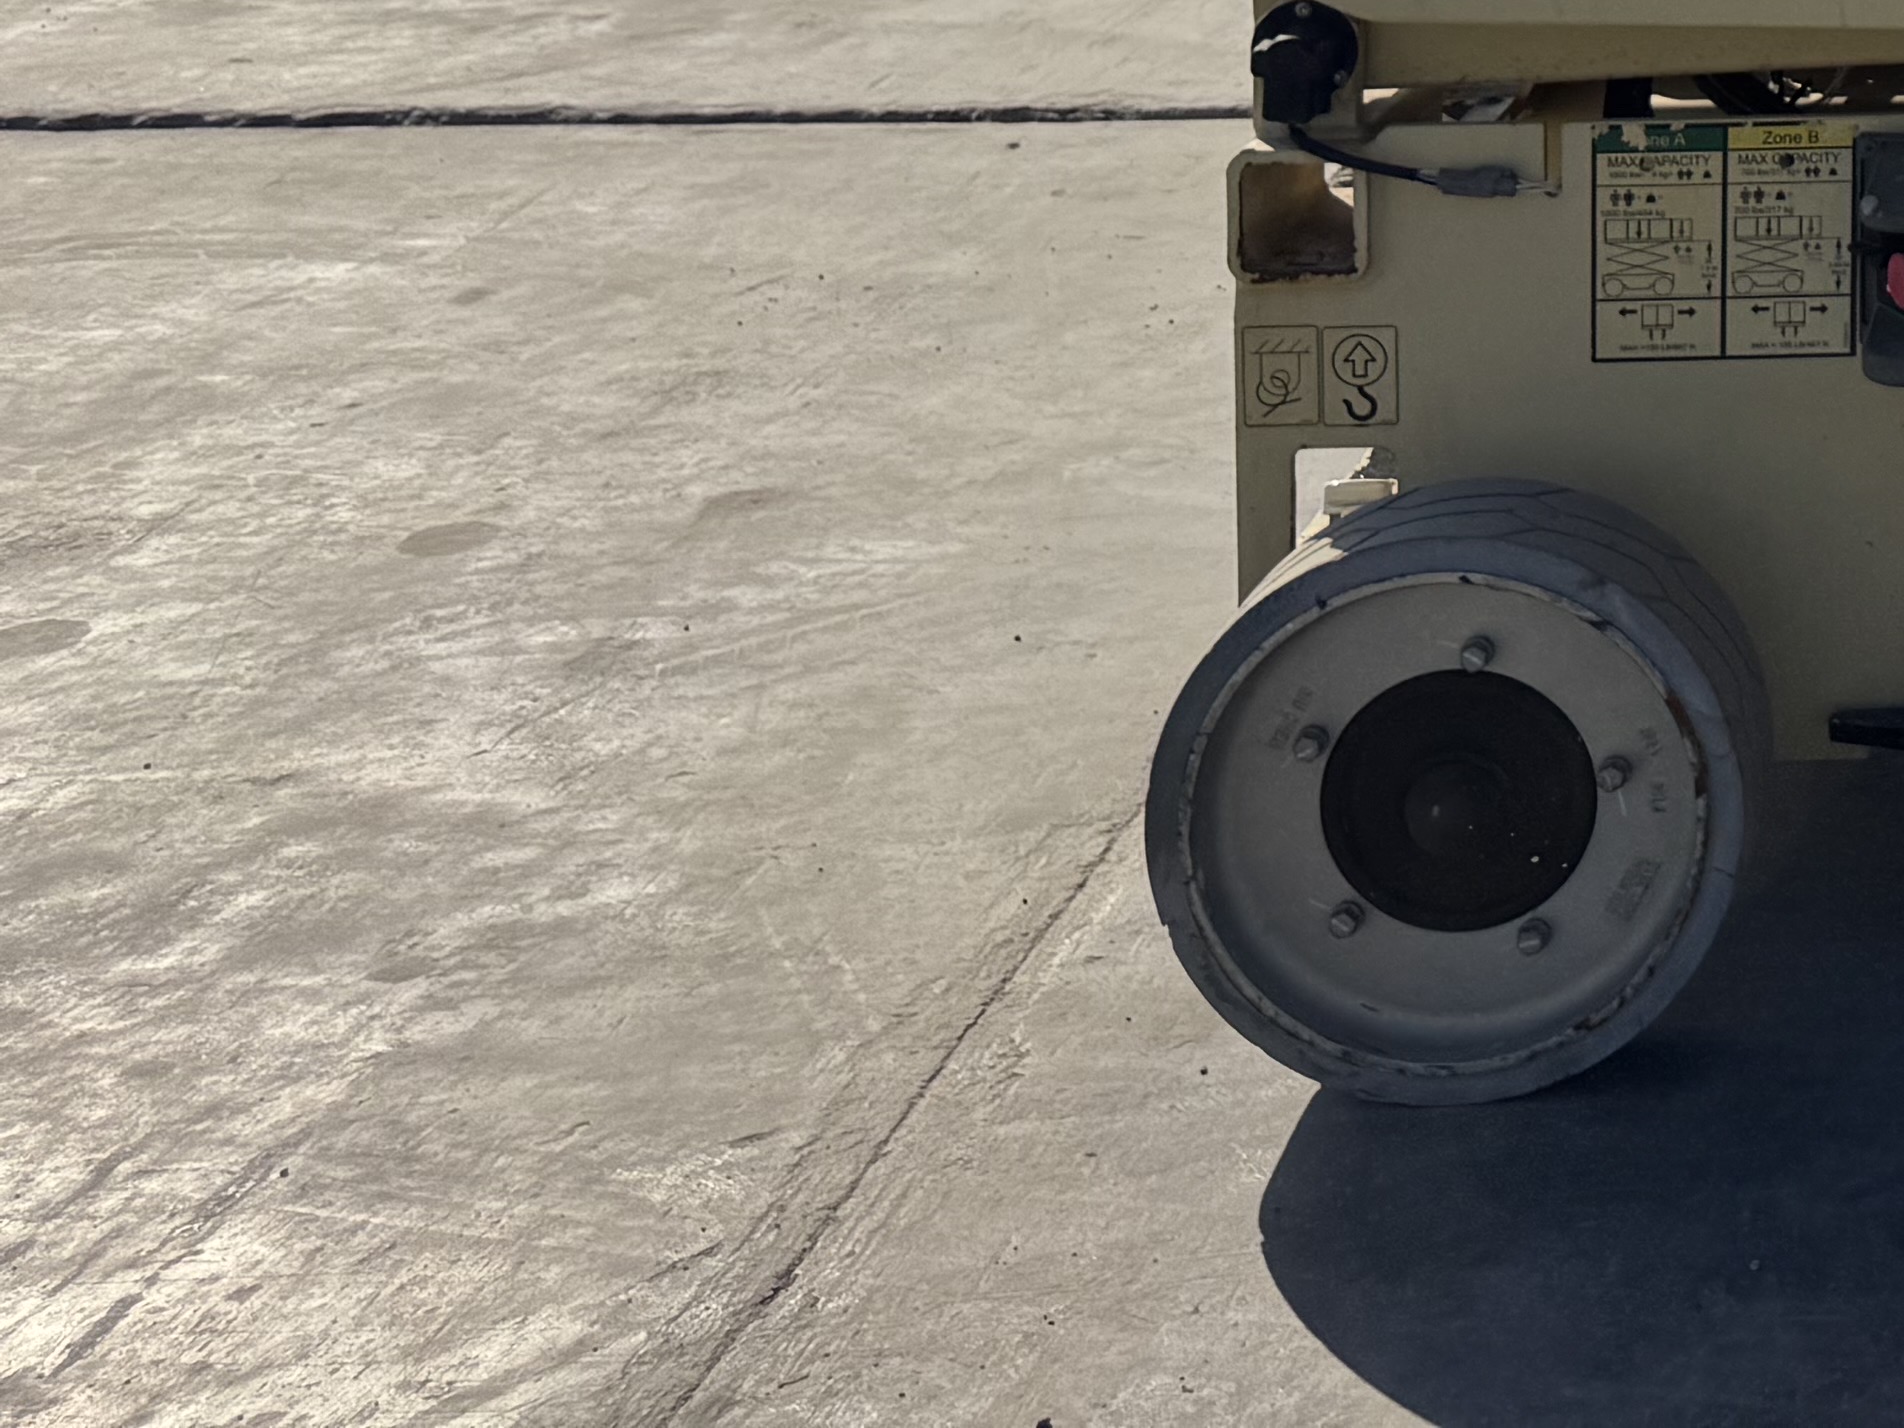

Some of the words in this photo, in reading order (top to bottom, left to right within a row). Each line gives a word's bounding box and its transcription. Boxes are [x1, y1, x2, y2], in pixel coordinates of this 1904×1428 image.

[1674, 132, 1686, 146] A
[1762, 130, 1803, 145] Zone
[1808, 129, 1820, 143] B
[1607, 154, 1638, 168] MAX
[1738, 152, 1769, 166] MAX
[1772, 151, 1842, 166] CPACITY
